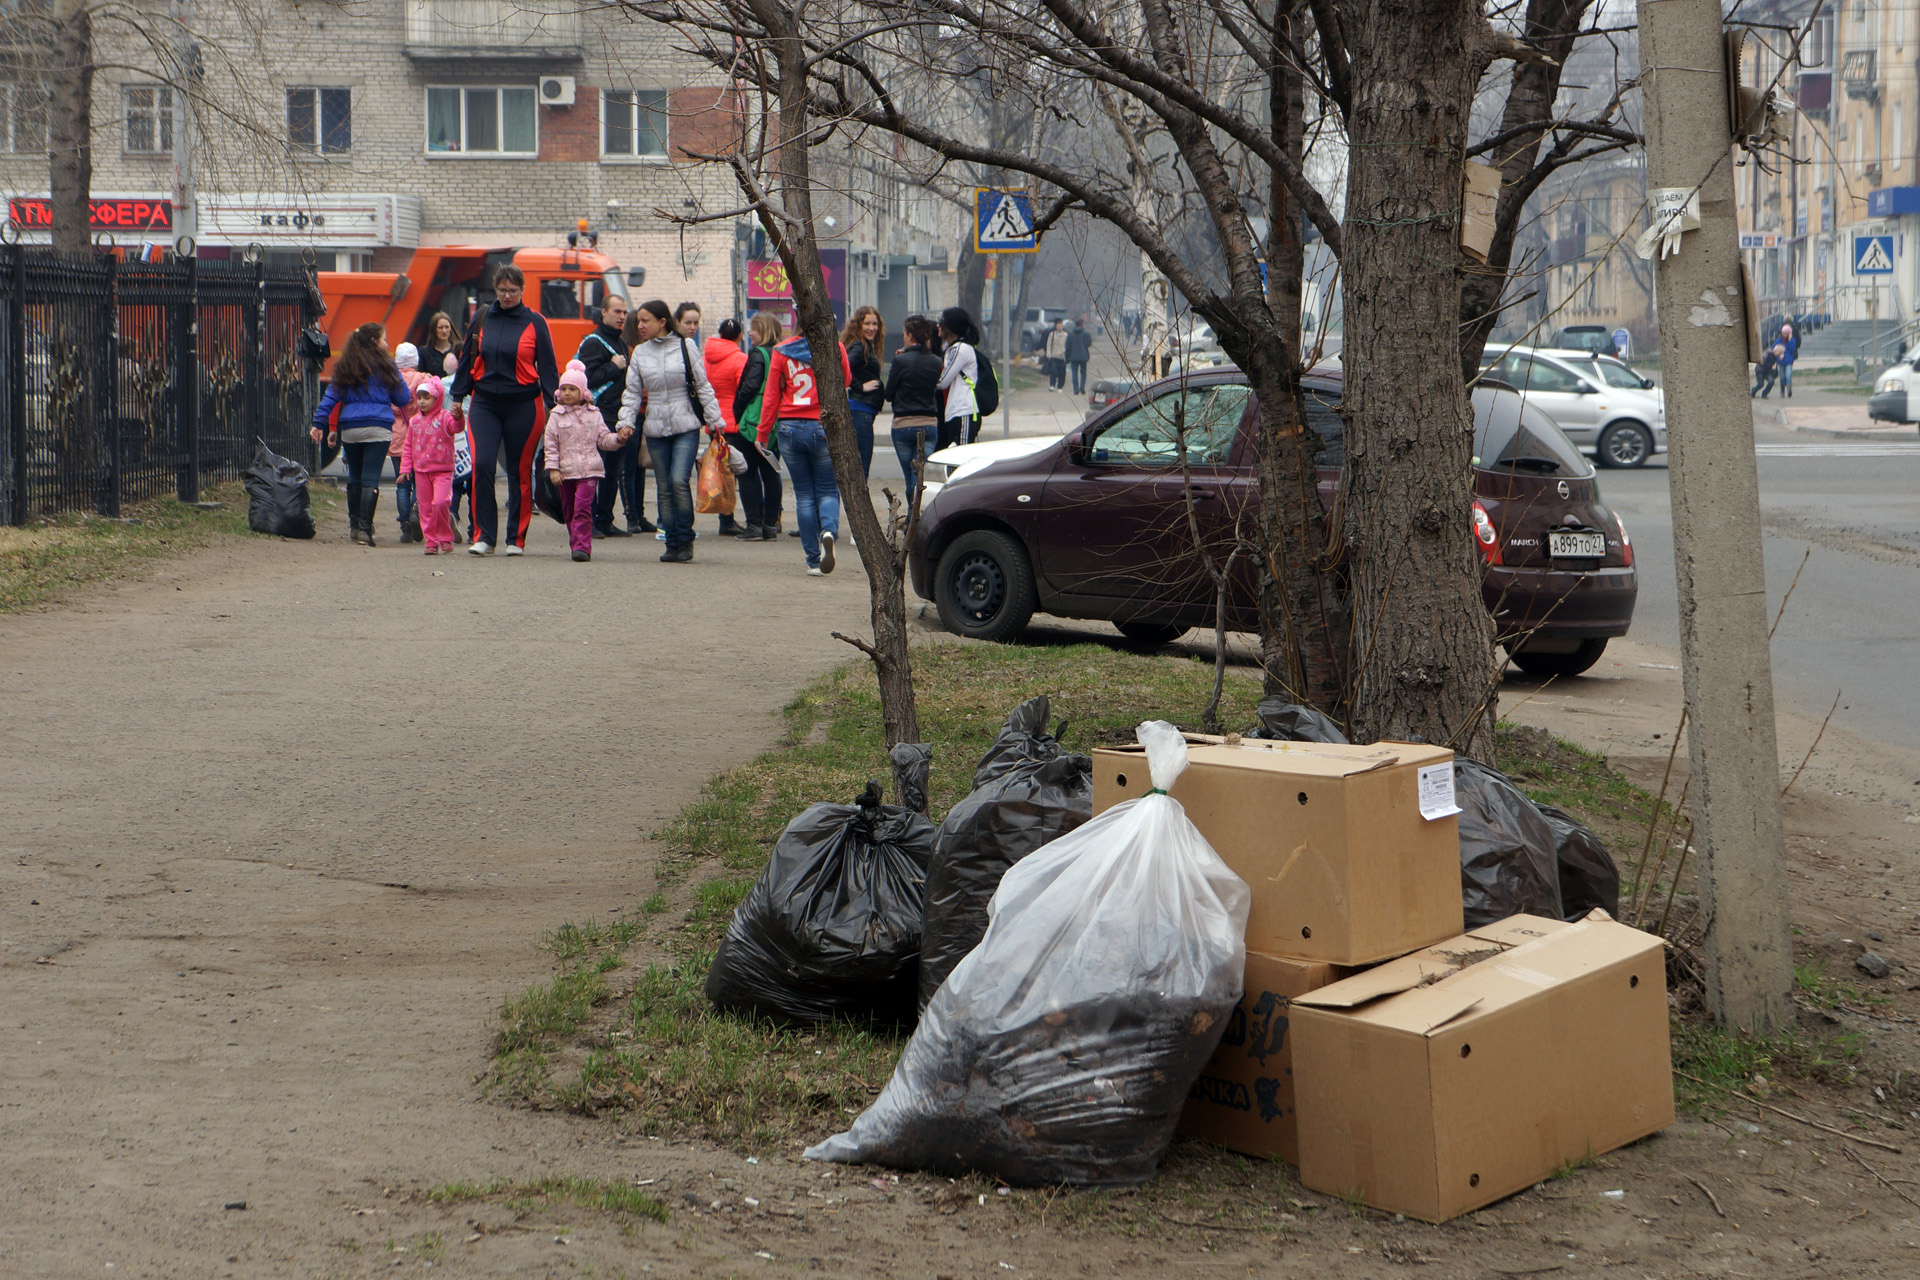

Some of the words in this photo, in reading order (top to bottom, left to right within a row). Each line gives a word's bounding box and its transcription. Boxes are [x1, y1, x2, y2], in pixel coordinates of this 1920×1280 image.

[10, 202, 169, 225] АТМСФЕРА
[792, 373, 813, 406] 2
[1510, 538, 1539, 546] MARCH
